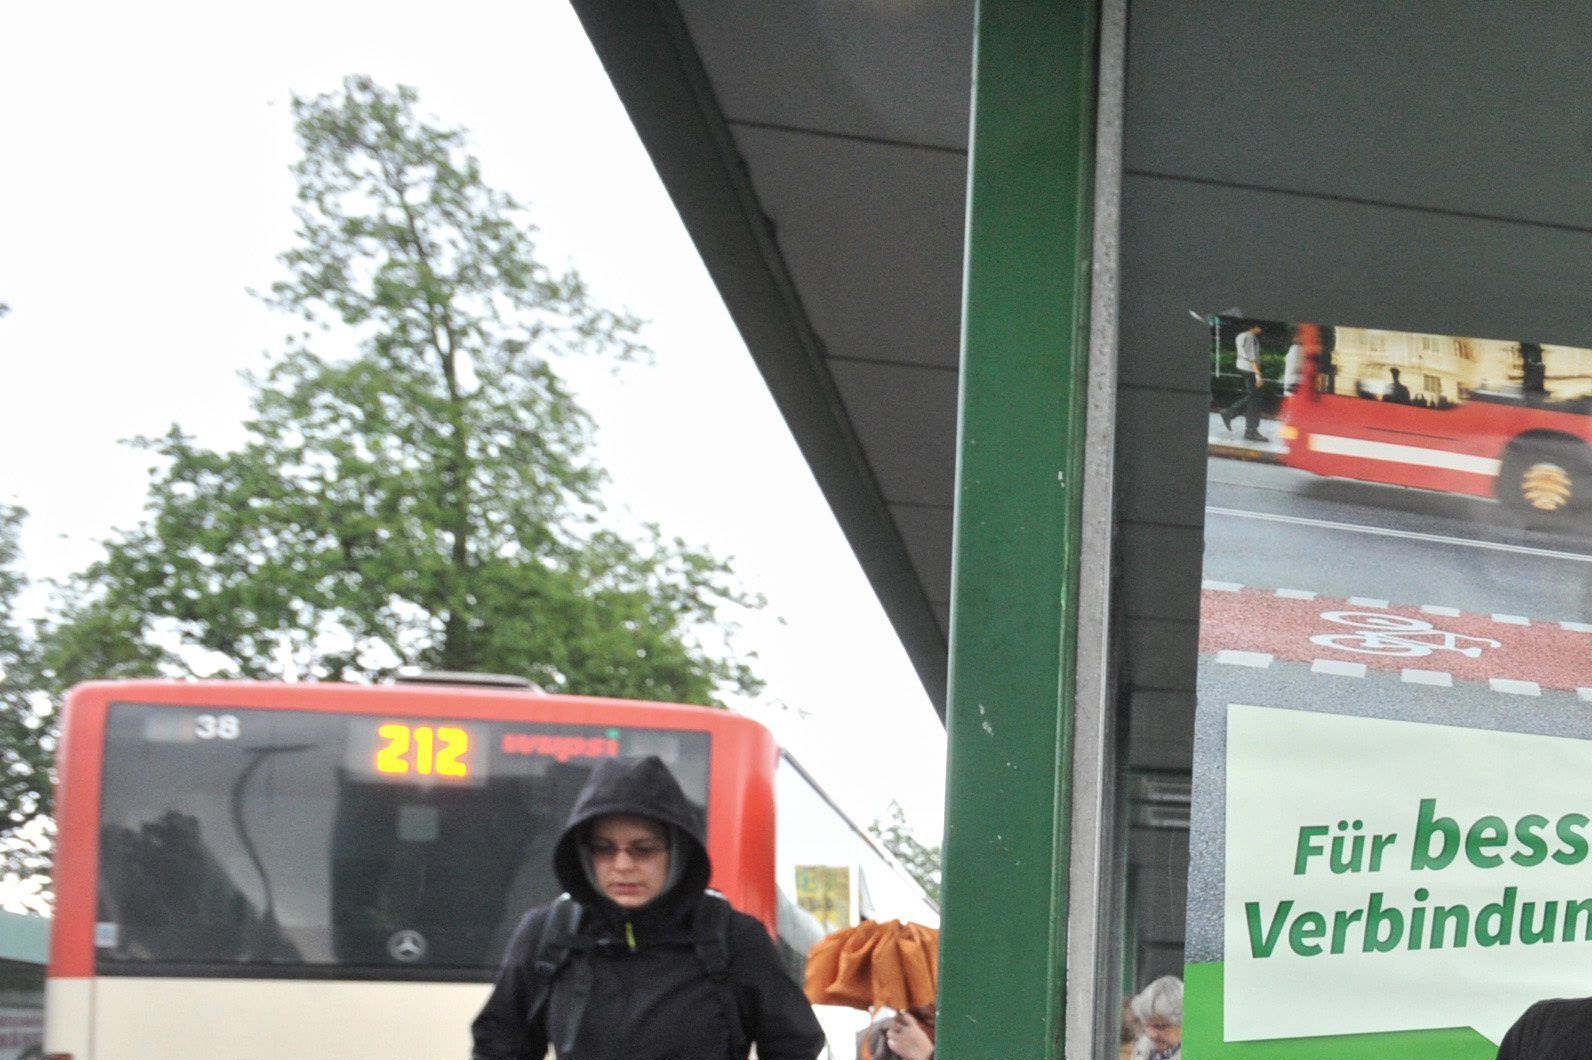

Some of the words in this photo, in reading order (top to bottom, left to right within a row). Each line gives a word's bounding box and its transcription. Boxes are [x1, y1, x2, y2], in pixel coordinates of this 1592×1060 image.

[195, 714, 240, 740] 38
[376, 724, 468, 777] 212
[1293, 819, 1398, 875] Für
